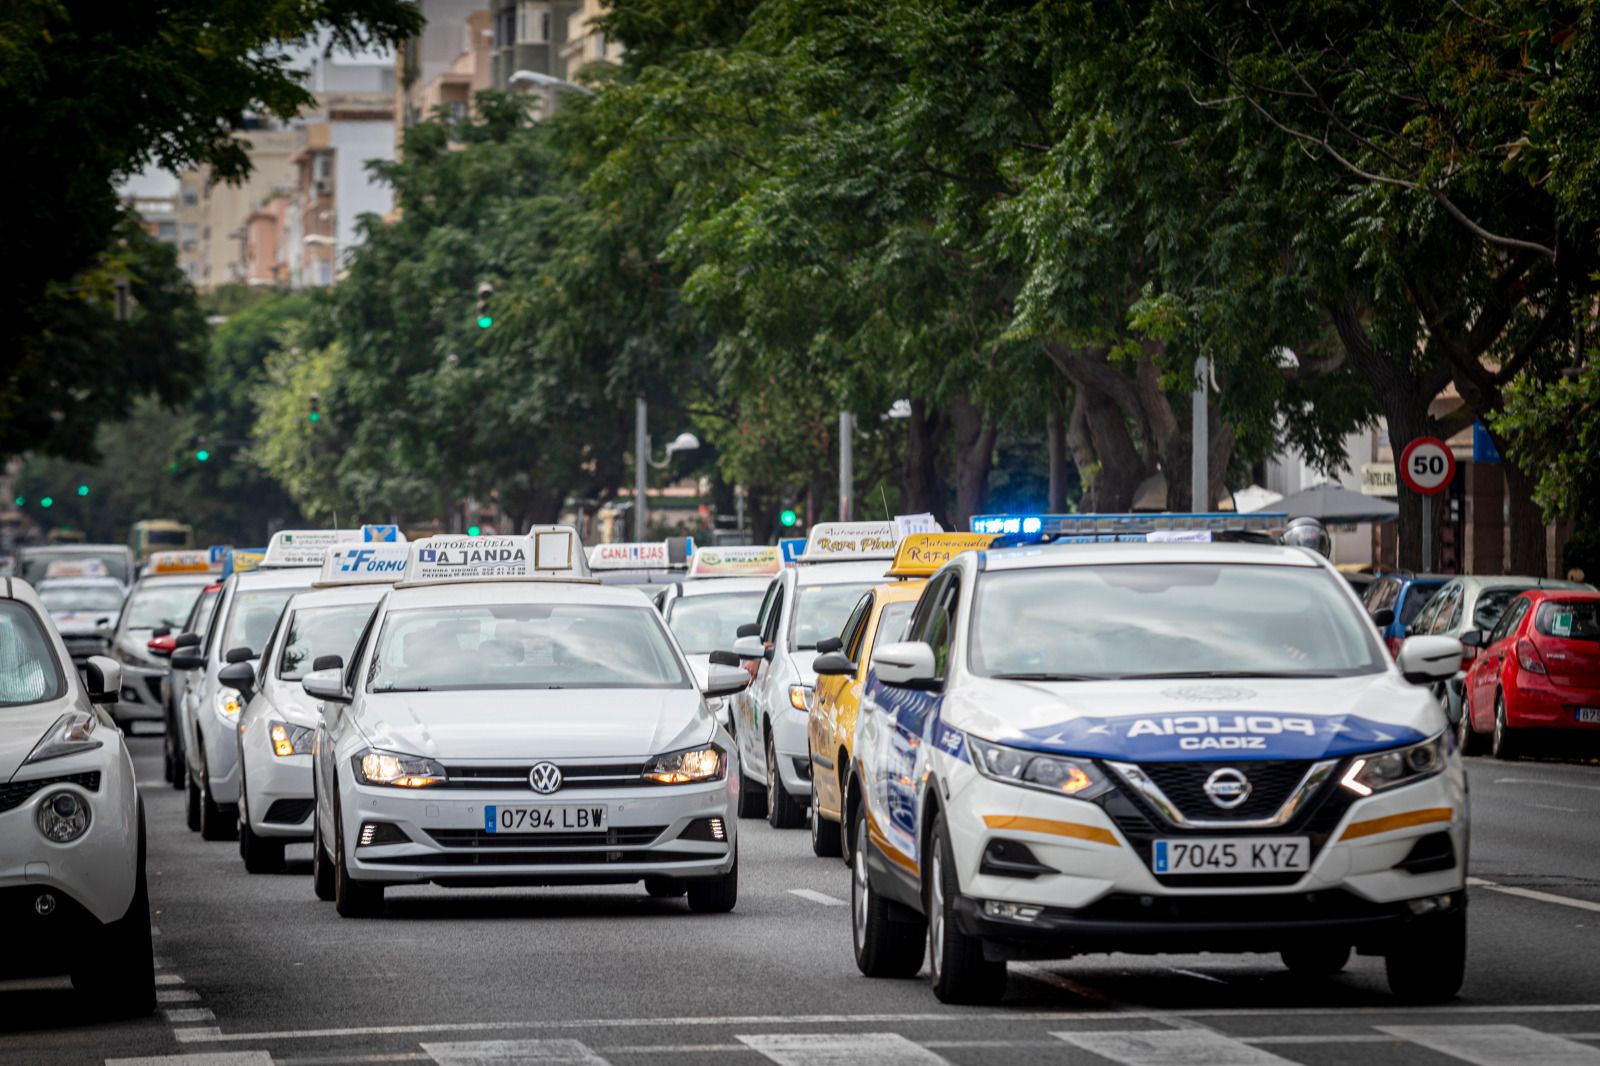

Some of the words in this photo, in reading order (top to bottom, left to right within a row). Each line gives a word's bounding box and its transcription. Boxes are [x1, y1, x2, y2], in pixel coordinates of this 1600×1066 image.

[1413, 455, 1444, 475] 50
[425, 541, 514, 549] AUTOESCUELA
[1179, 737, 1267, 750] CADIZ
[501, 809, 554, 828] 0794
[563, 808, 603, 828] LBW
[1173, 843, 1238, 868] 7045
[1252, 843, 1299, 868] KYZ
